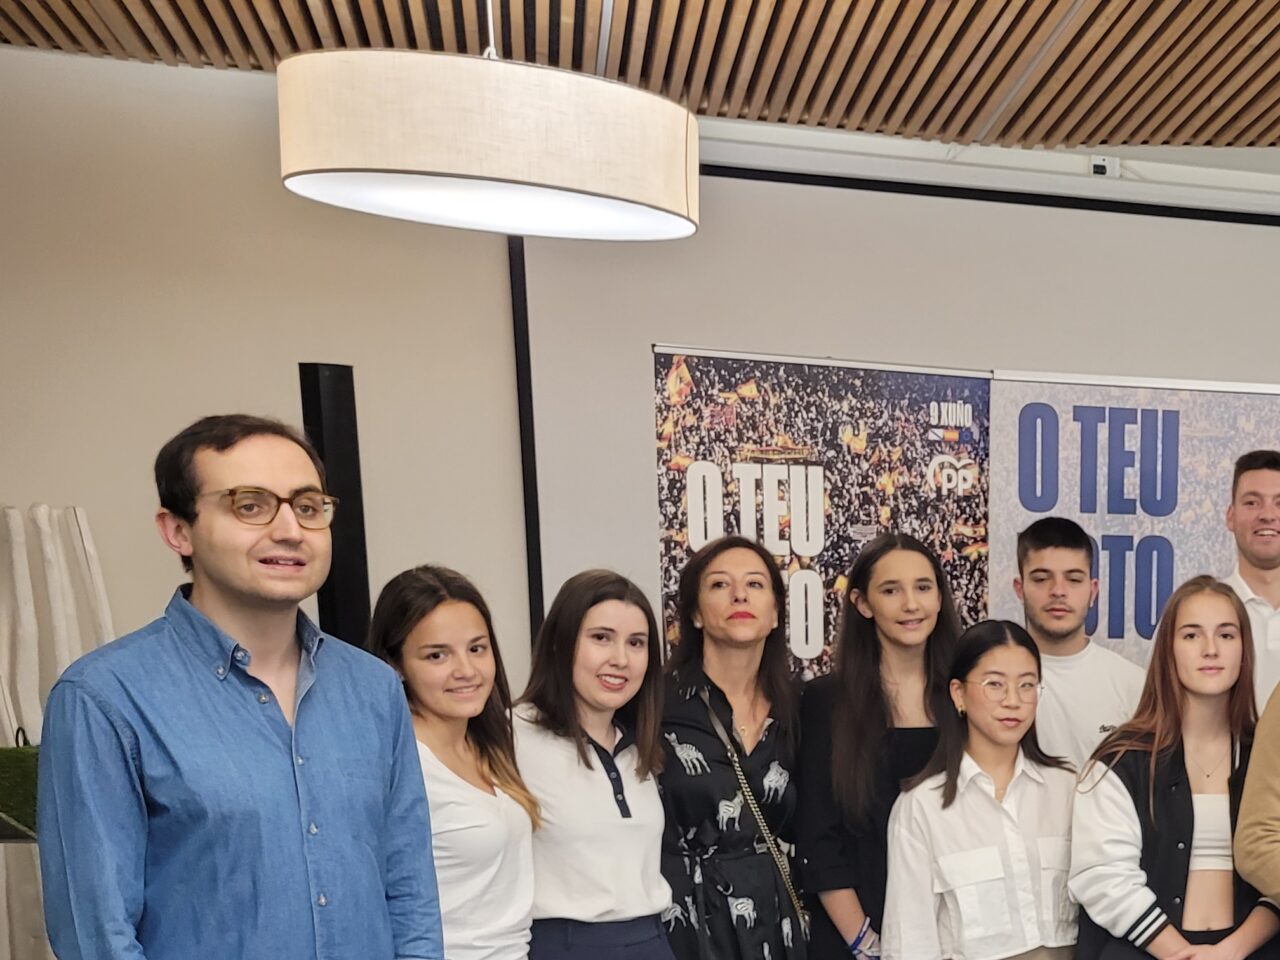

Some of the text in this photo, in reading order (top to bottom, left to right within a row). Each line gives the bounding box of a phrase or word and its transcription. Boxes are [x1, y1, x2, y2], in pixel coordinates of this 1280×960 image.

[929, 400, 973, 428] 9 XUÑO
[1018, 402, 1180, 517] O TEU
[686, 460, 825, 557] O TEU
[1085, 535, 1175, 640] TO
